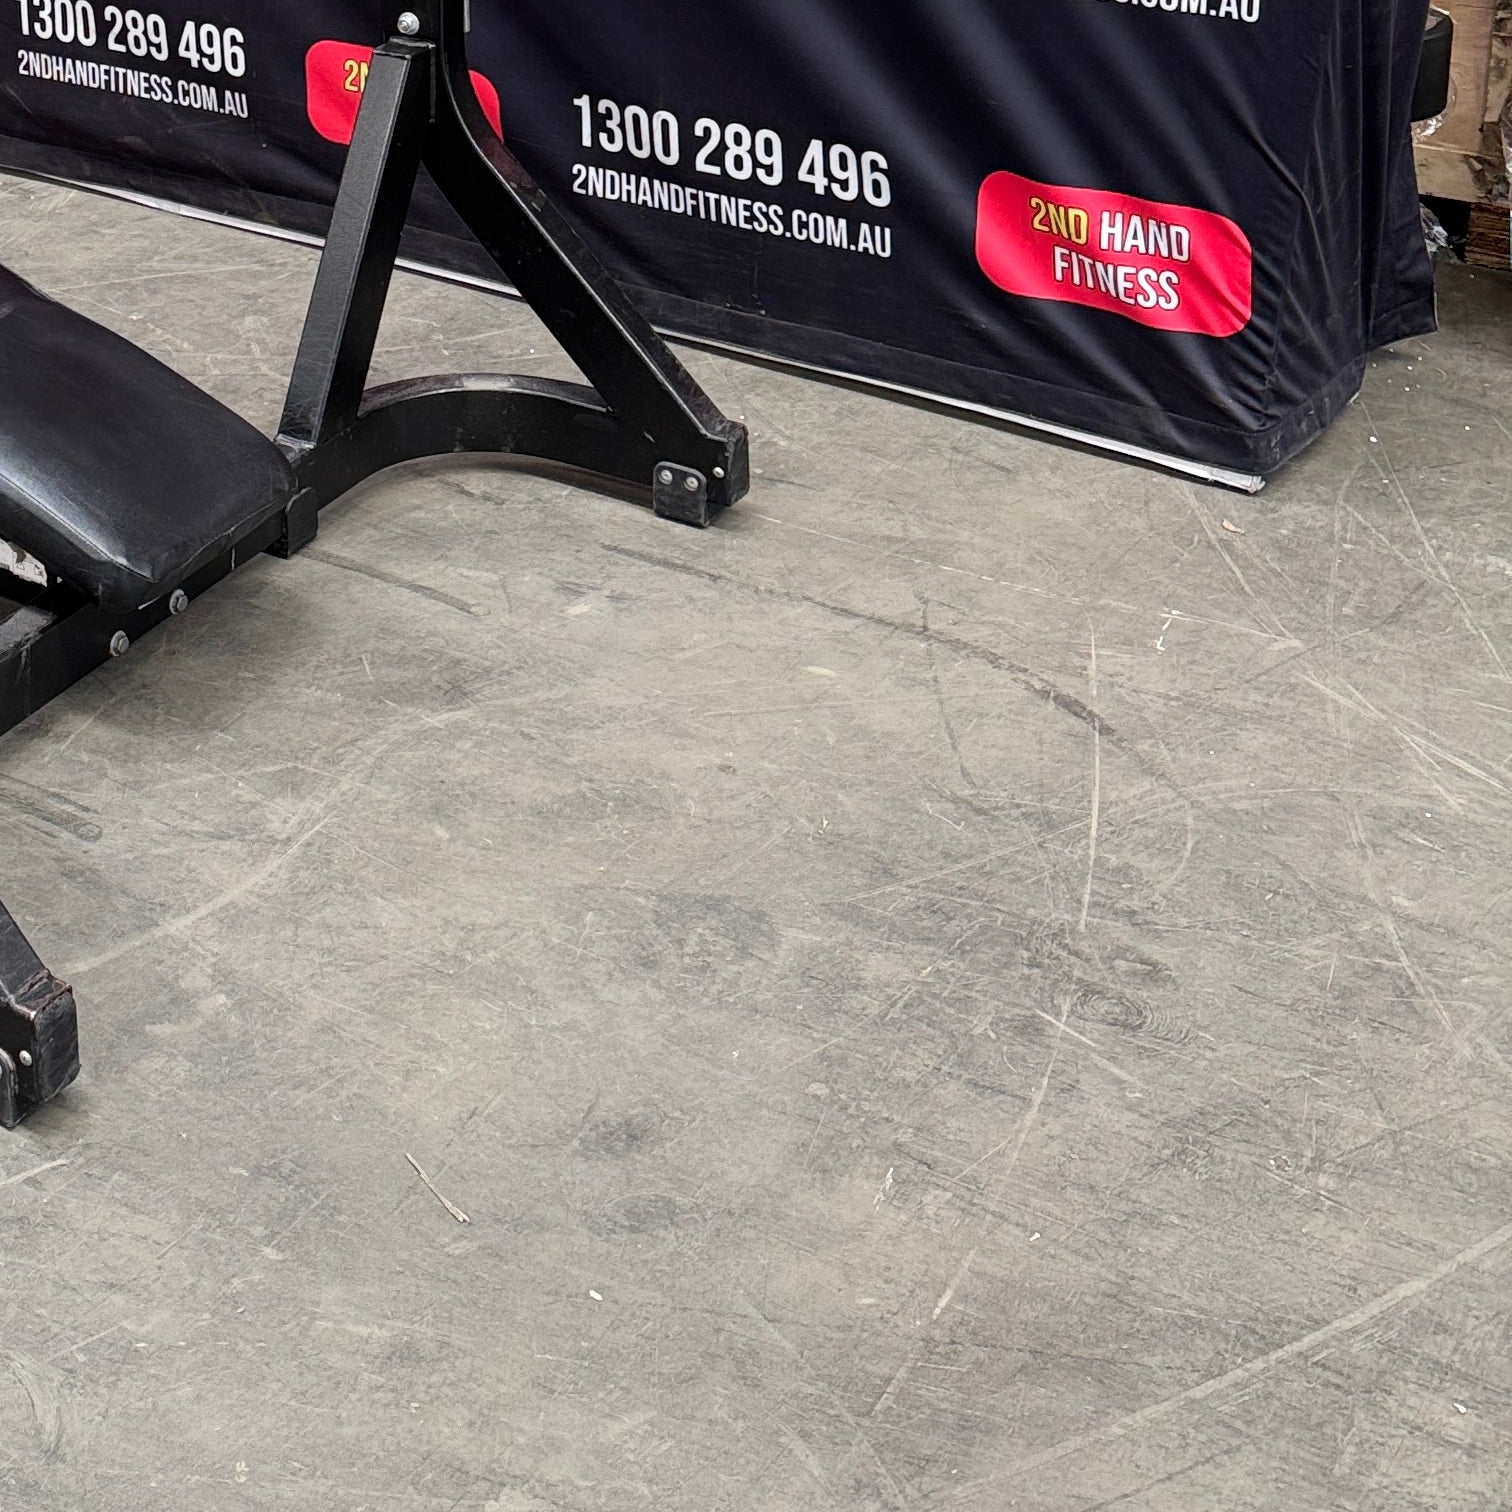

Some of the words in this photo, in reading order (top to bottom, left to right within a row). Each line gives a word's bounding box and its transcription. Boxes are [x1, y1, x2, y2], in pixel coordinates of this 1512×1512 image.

[103, 5, 169, 62] 289
[178, 20, 246, 78] 496
[17, 49, 249, 119] 2NDHANDFITNESS.COM.AU
[573, 94, 680, 166] 1300
[694, 117, 783, 186] 289
[797, 138, 891, 208] 496
[570, 161, 892, 259] 2NDHANDFITNESS.COM.AU
[1030, 197, 1088, 245] 2ND
[1100, 211, 1190, 262] HAND
[1054, 246, 1179, 310] FITNESS
